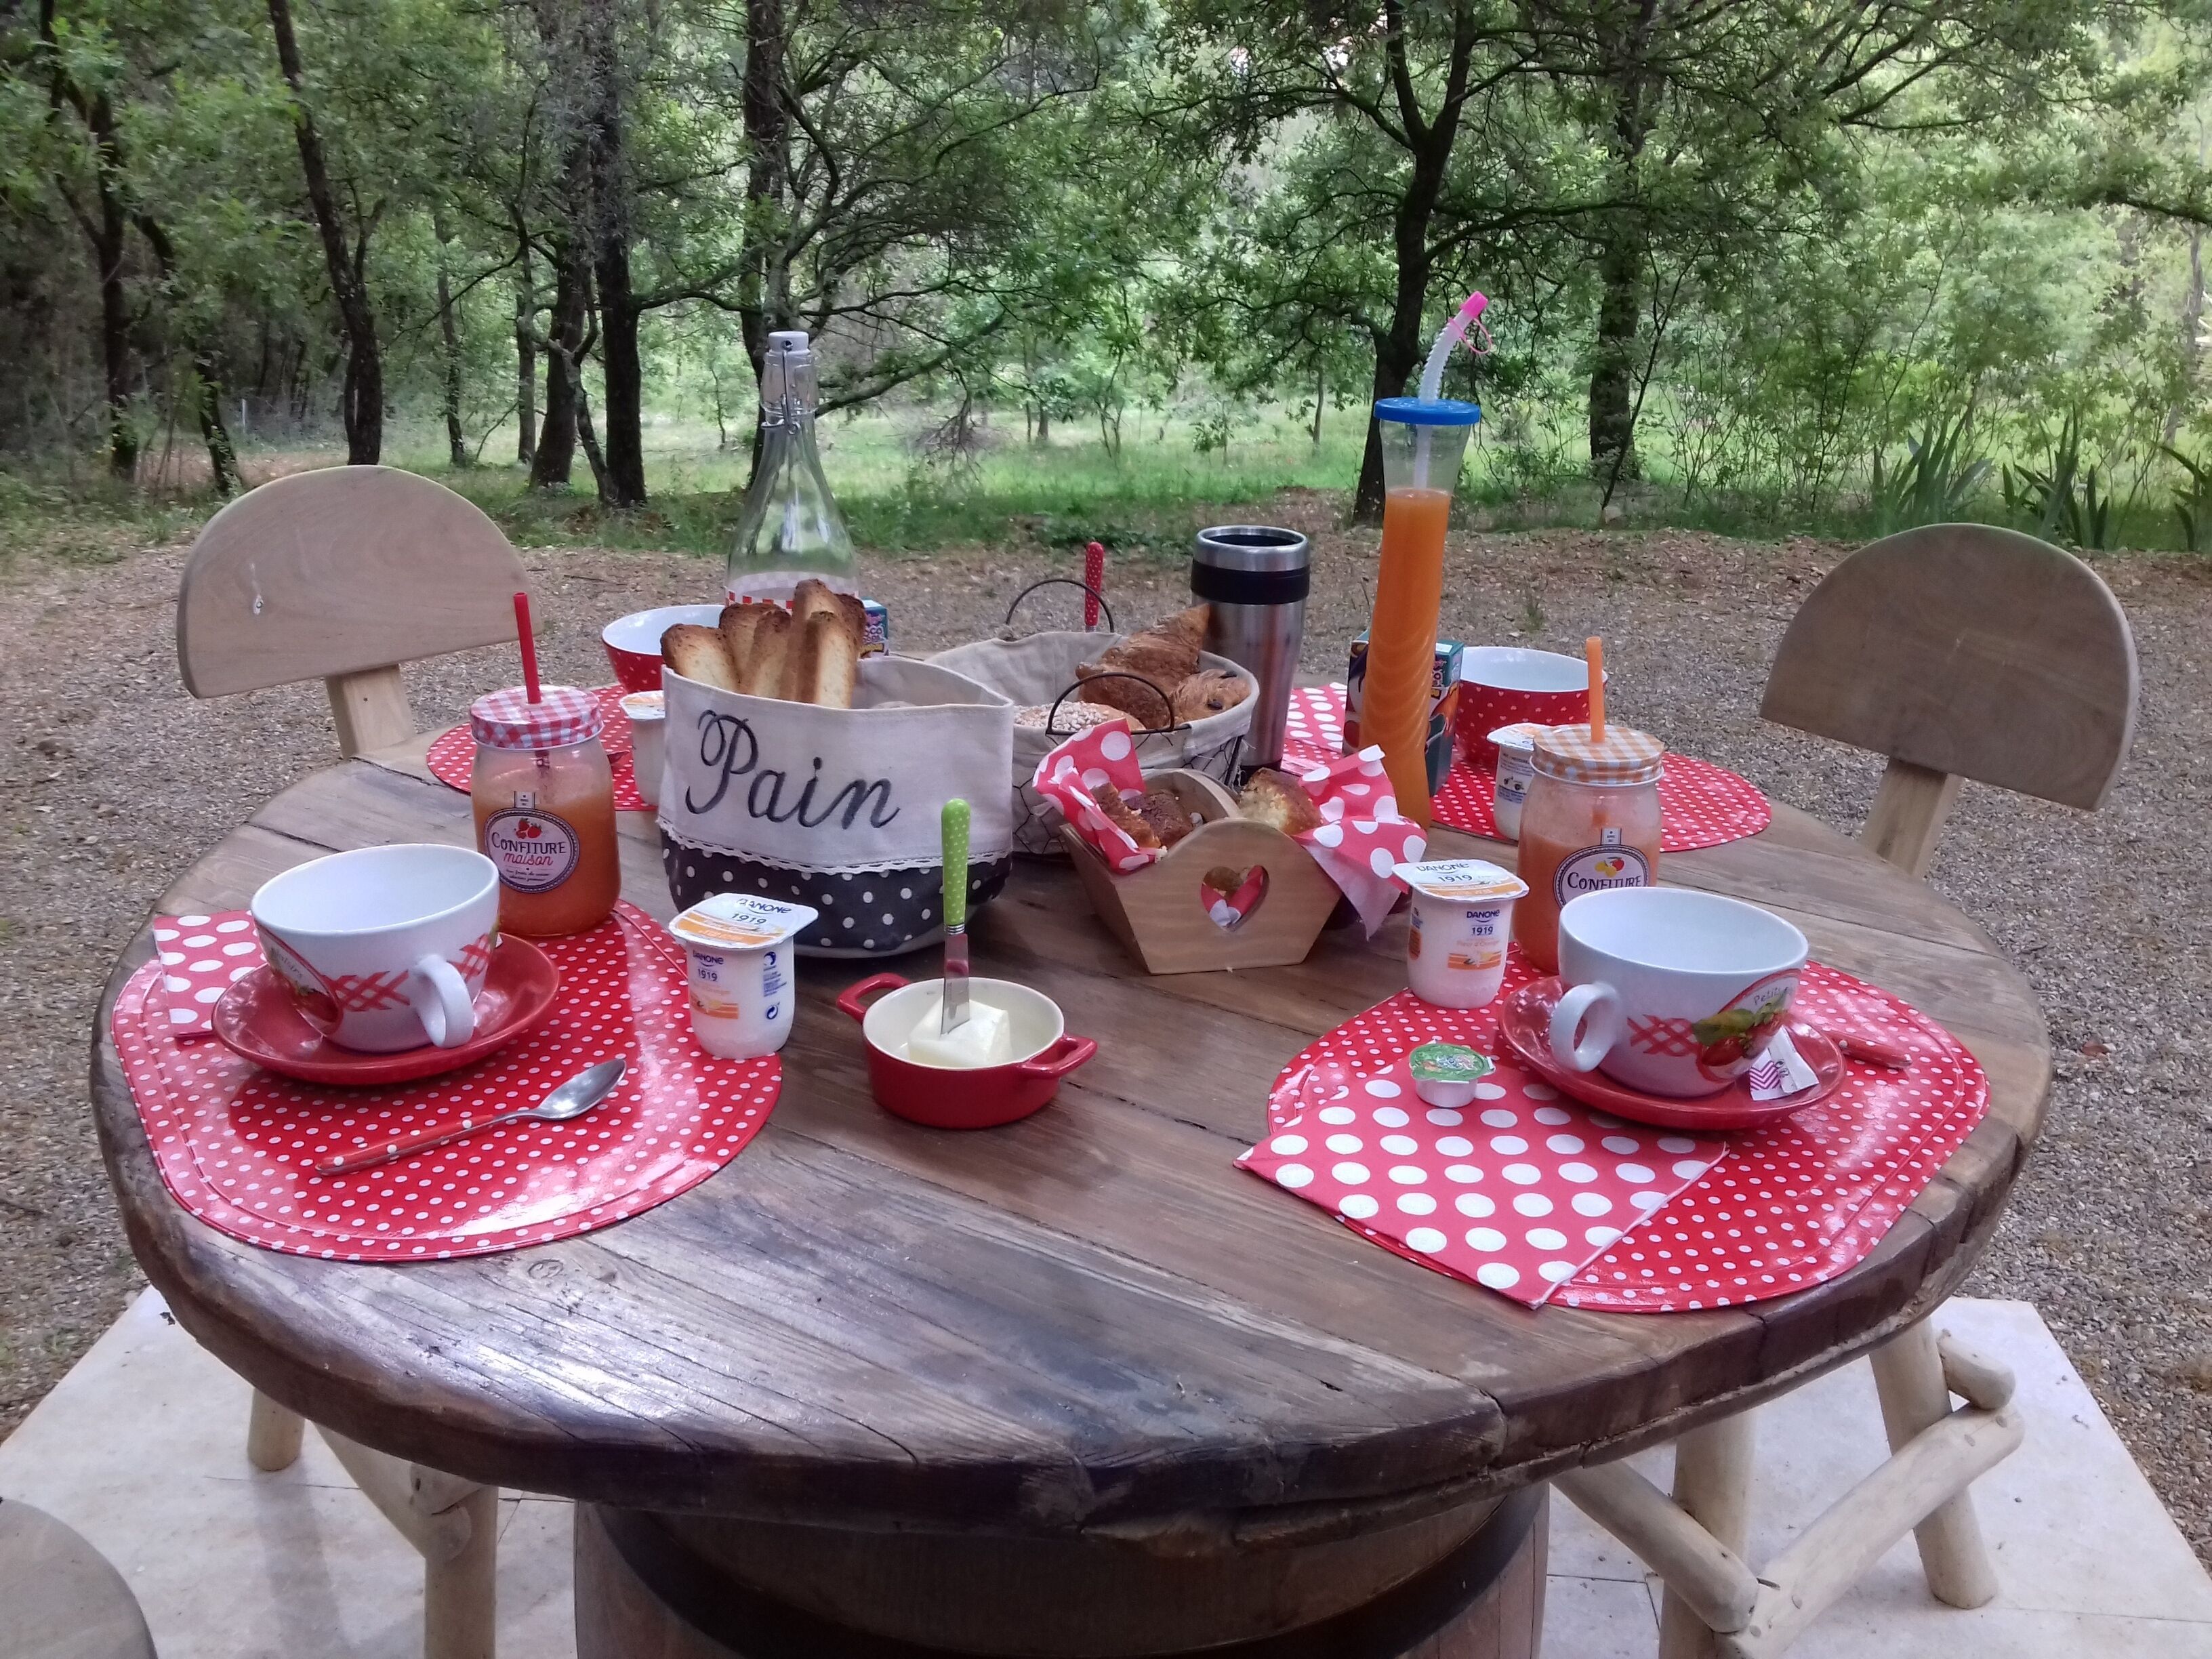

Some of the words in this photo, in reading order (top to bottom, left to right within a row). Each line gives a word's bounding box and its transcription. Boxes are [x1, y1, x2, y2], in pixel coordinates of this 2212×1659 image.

[685, 709, 901, 830] Pain
[504, 853, 553, 865] maison
[1467, 909, 1500, 918] DANONE
[732, 914, 766, 925] 1919
[1471, 926, 1494, 936] 1919
[697, 968, 718, 981] 1919
